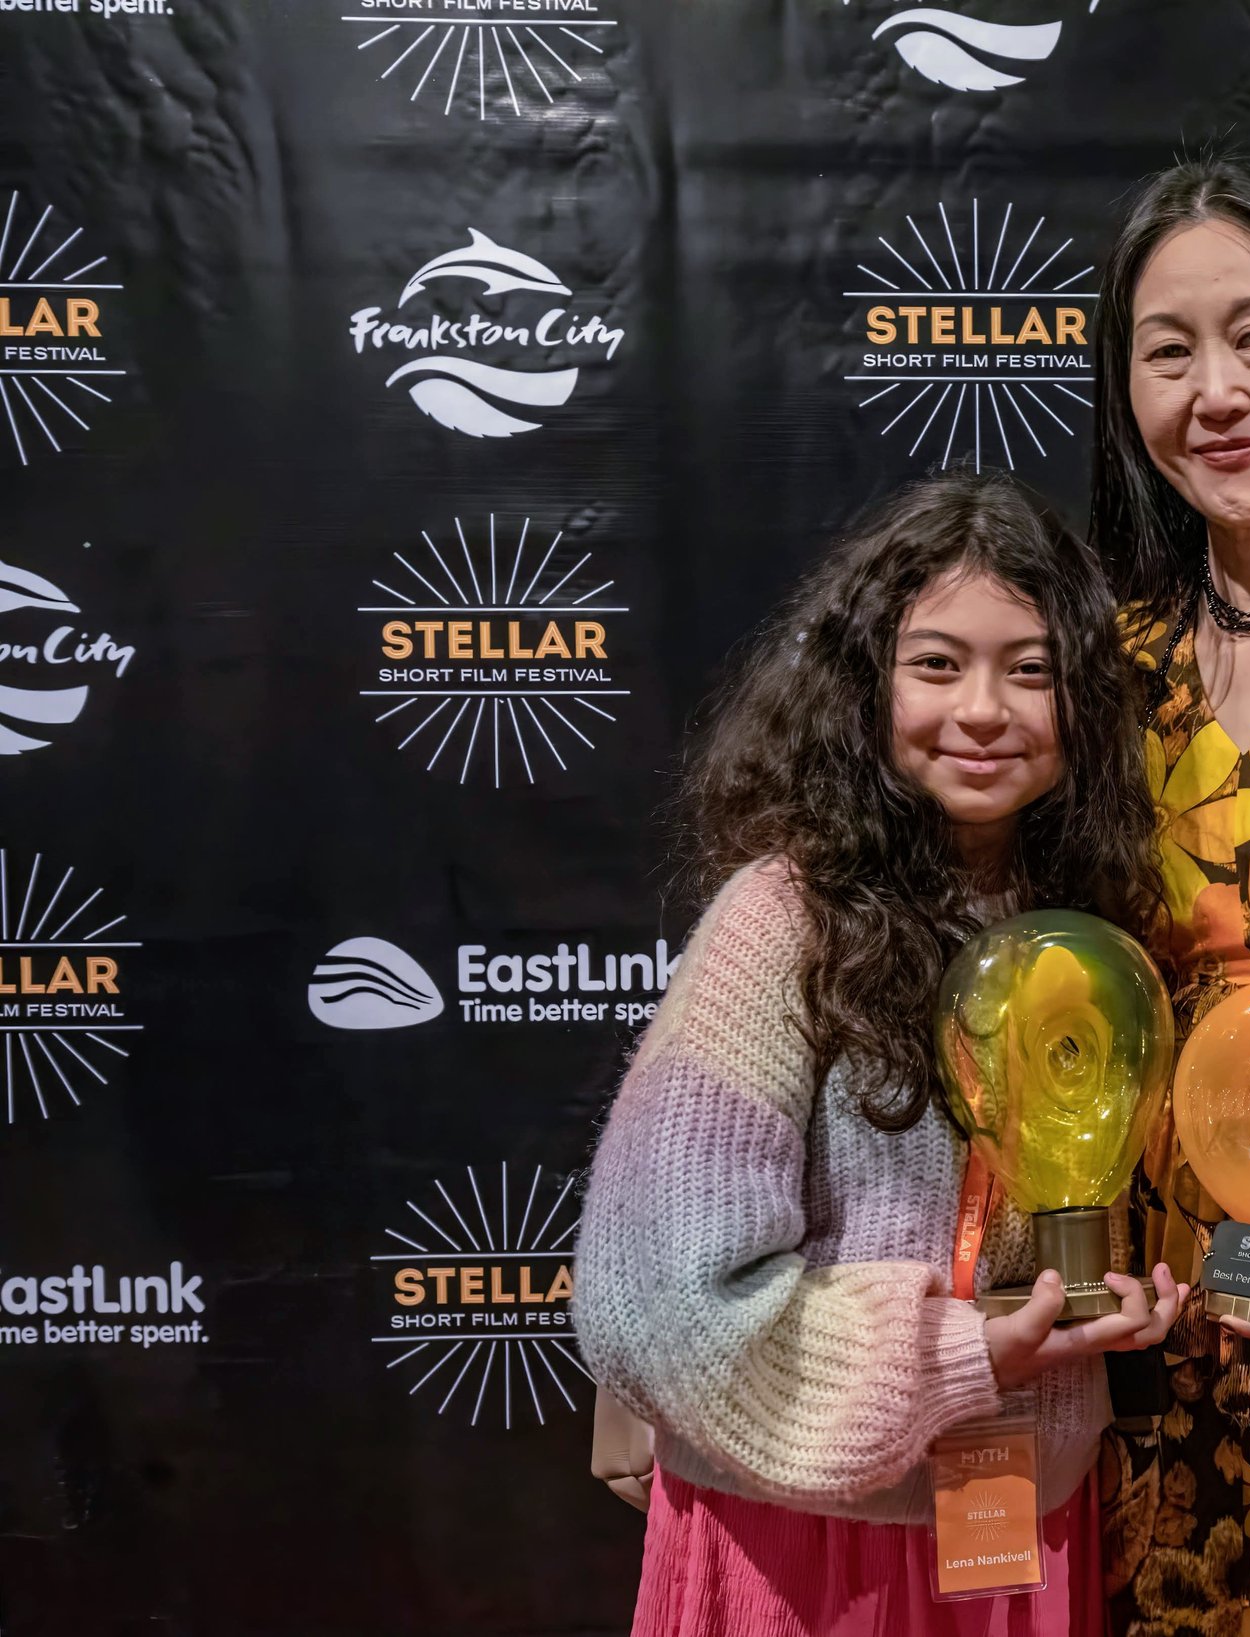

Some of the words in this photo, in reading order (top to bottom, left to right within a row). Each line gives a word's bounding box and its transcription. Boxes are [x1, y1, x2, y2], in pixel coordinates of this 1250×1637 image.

[500, 0, 598, 12] FESTIVAL
[349, 307, 528, 354] Frankston
[535, 308, 626, 361] City
[866, 305, 1088, 345] STELLAR
[5, 346, 106, 361] FESTIVAL
[863, 353, 936, 368] SHORT
[943, 354, 988, 368] FILM
[996, 354, 1091, 368] FESTIVAL
[381, 620, 608, 660] STELLAR
[43, 625, 136, 678] City
[378, 668, 454, 683] SHORT
[460, 668, 507, 682] FILM
[514, 668, 612, 682] FESTIVAL
[27, 1003, 124, 1017] FESTIVAL
[459, 997, 523, 1021] Time
[529, 997, 609, 1021] better
[958, 1194, 980, 1262] STELLAR
[1213, 1269, 1233, 1281] Best
[0, 1261, 206, 1316] astLink
[390, 1313, 466, 1329] SHORT
[471, 1312, 518, 1327] FILM
[44, 1319, 125, 1344] better
[130, 1320, 209, 1349] spent.
[961, 1446, 1009, 1465] MYTH
[967, 1509, 1006, 1520] STELLAR
[946, 1558, 974, 1570] Lena
[977, 1550, 1032, 1566] Nankivell
